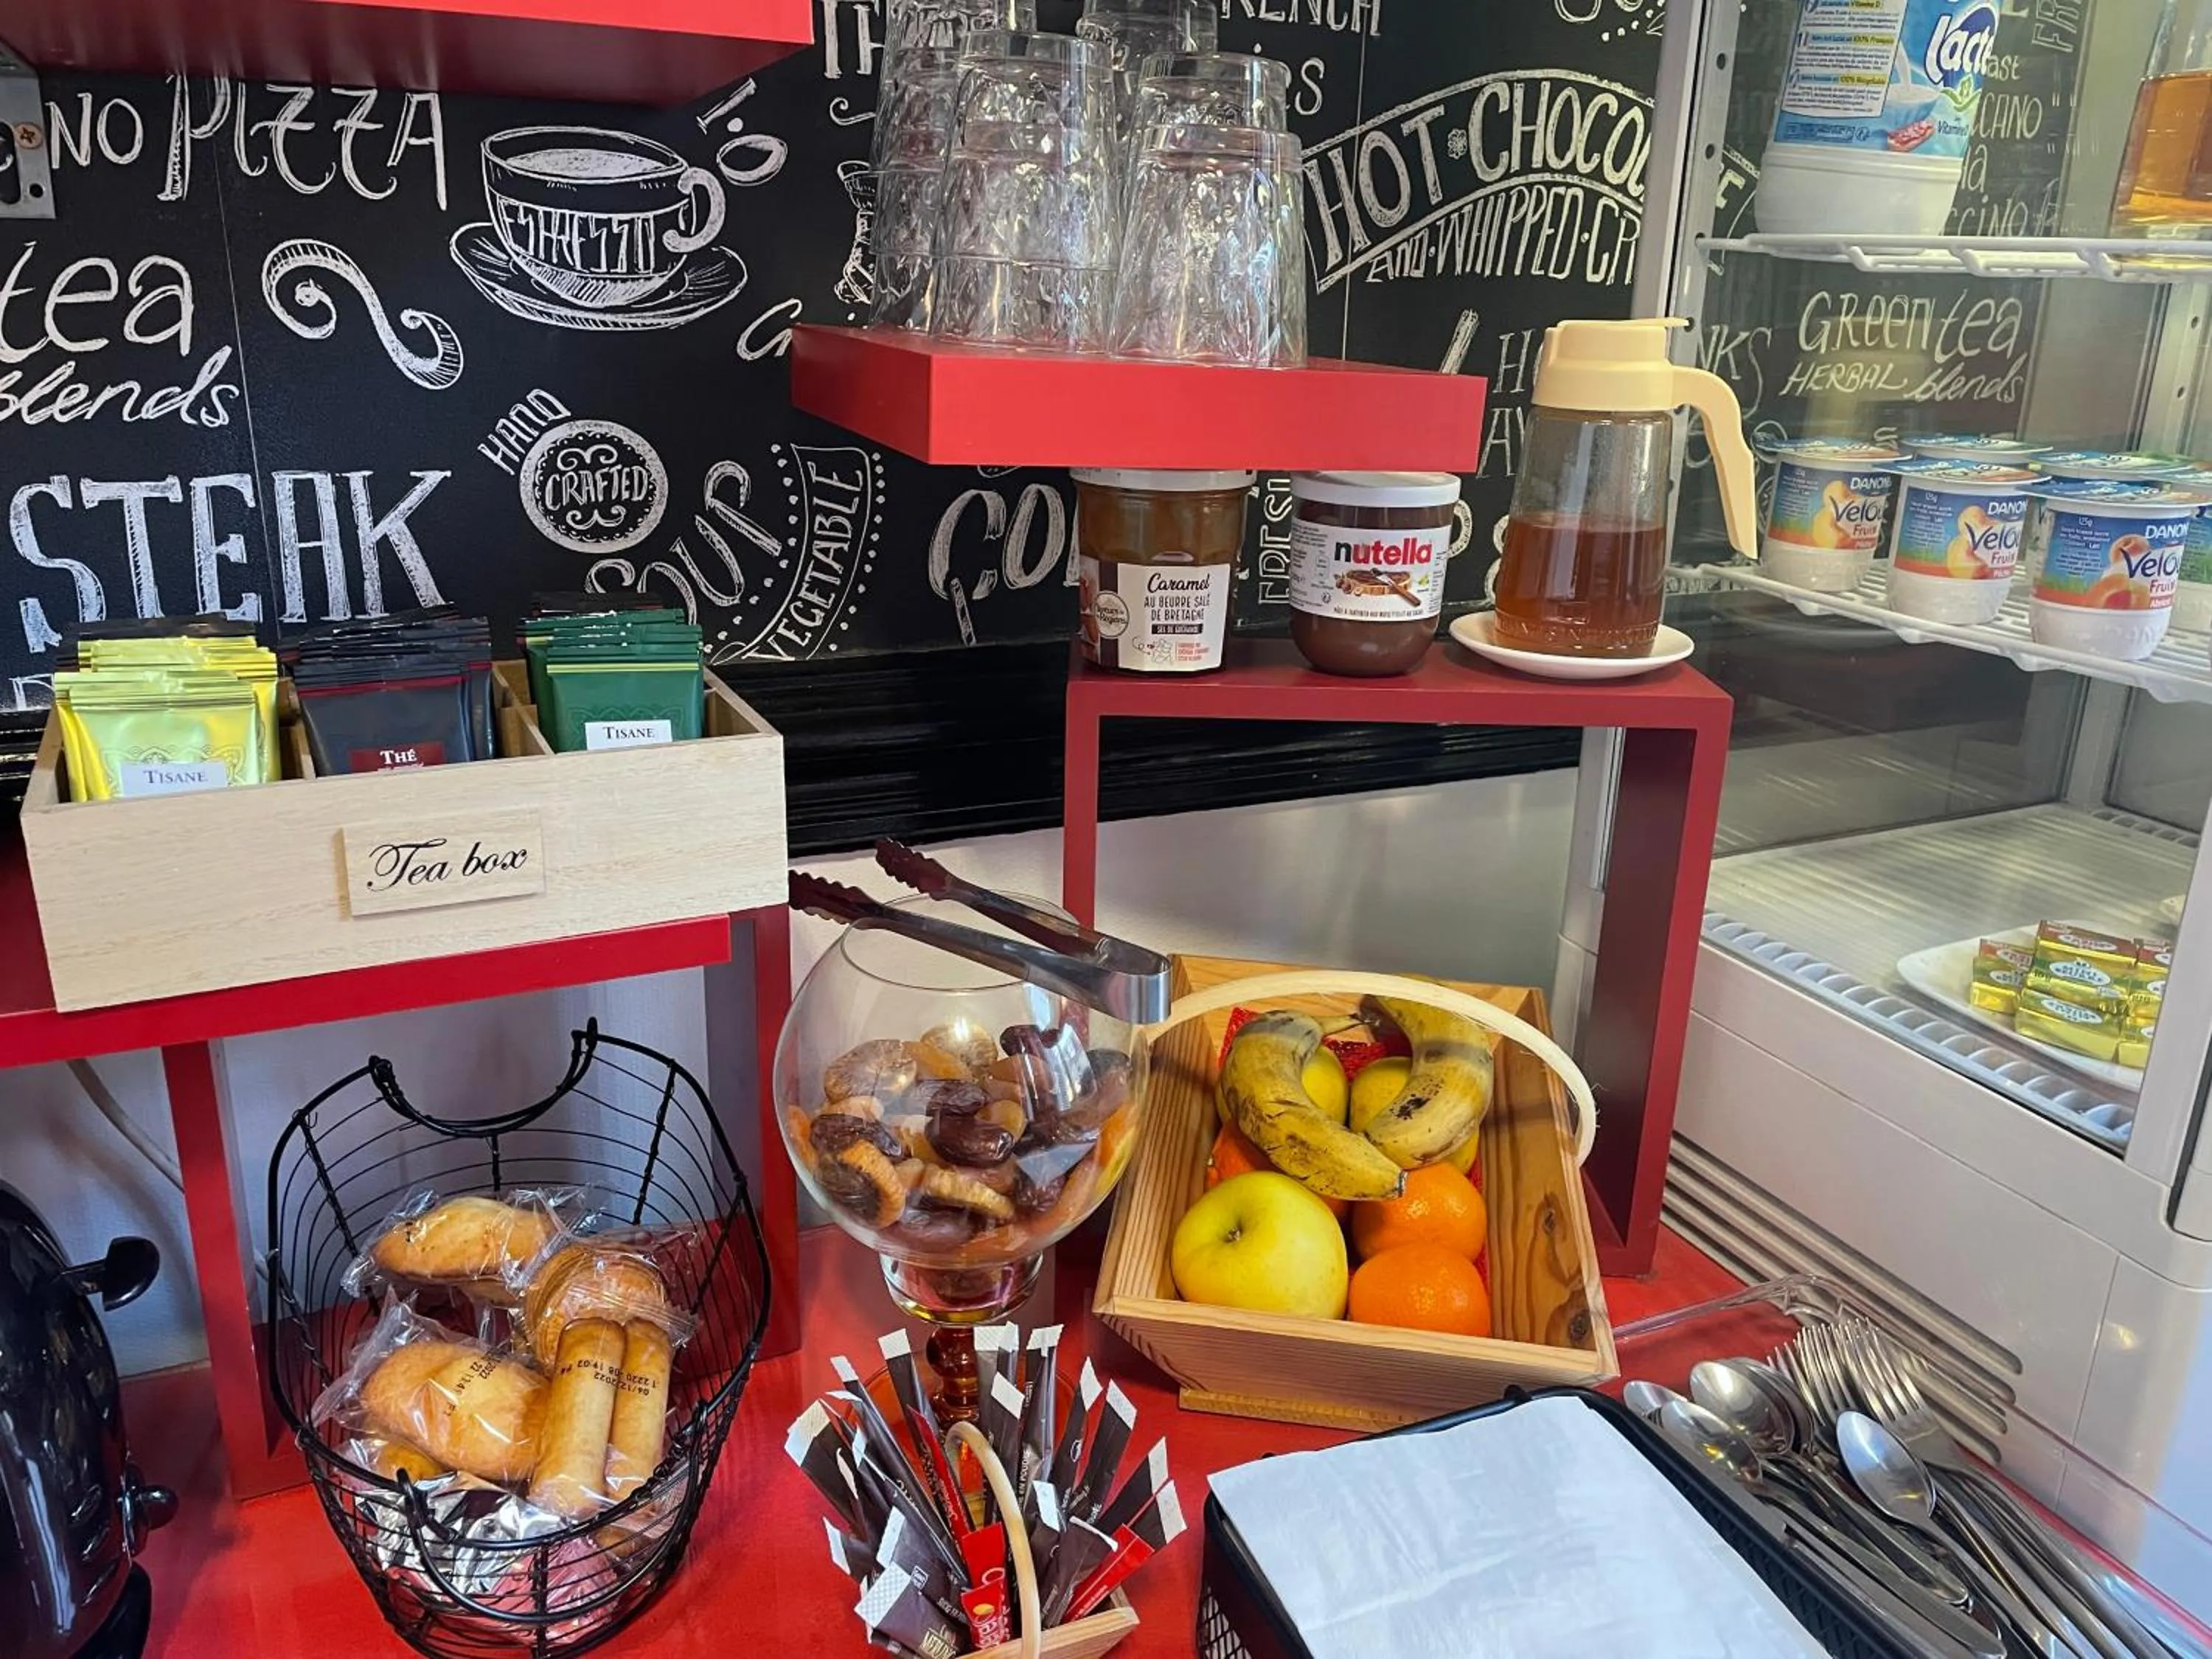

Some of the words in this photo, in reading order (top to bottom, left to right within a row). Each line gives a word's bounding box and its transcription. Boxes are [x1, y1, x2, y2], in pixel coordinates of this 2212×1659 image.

[1303, 105, 1445, 271] HOT
[1436, 184, 1583, 280] WHIPPED
[0, 241, 194, 363] tea
[1934, 288, 2023, 363] tea
[1779, 359, 1910, 395] HERBAL
[1904, 352, 2028, 403] blends
[546, 465, 650, 510] CRAFTED
[10, 470, 452, 653] STEAK
[741, 460, 864, 662] VEGETABLE
[1334, 537, 1433, 566] nutella
[1144, 595, 1156, 608] AU
[1158, 594, 1191, 609] BEURRE
[1147, 572, 1211, 594] Caramel
[1151, 609, 1162, 622] DE
[379, 748, 418, 765] THÉ
[602, 725, 655, 740] TISANE
[142, 765, 209, 786] TISANE
[366, 837, 453, 892] Tea
[462, 841, 529, 877] box
